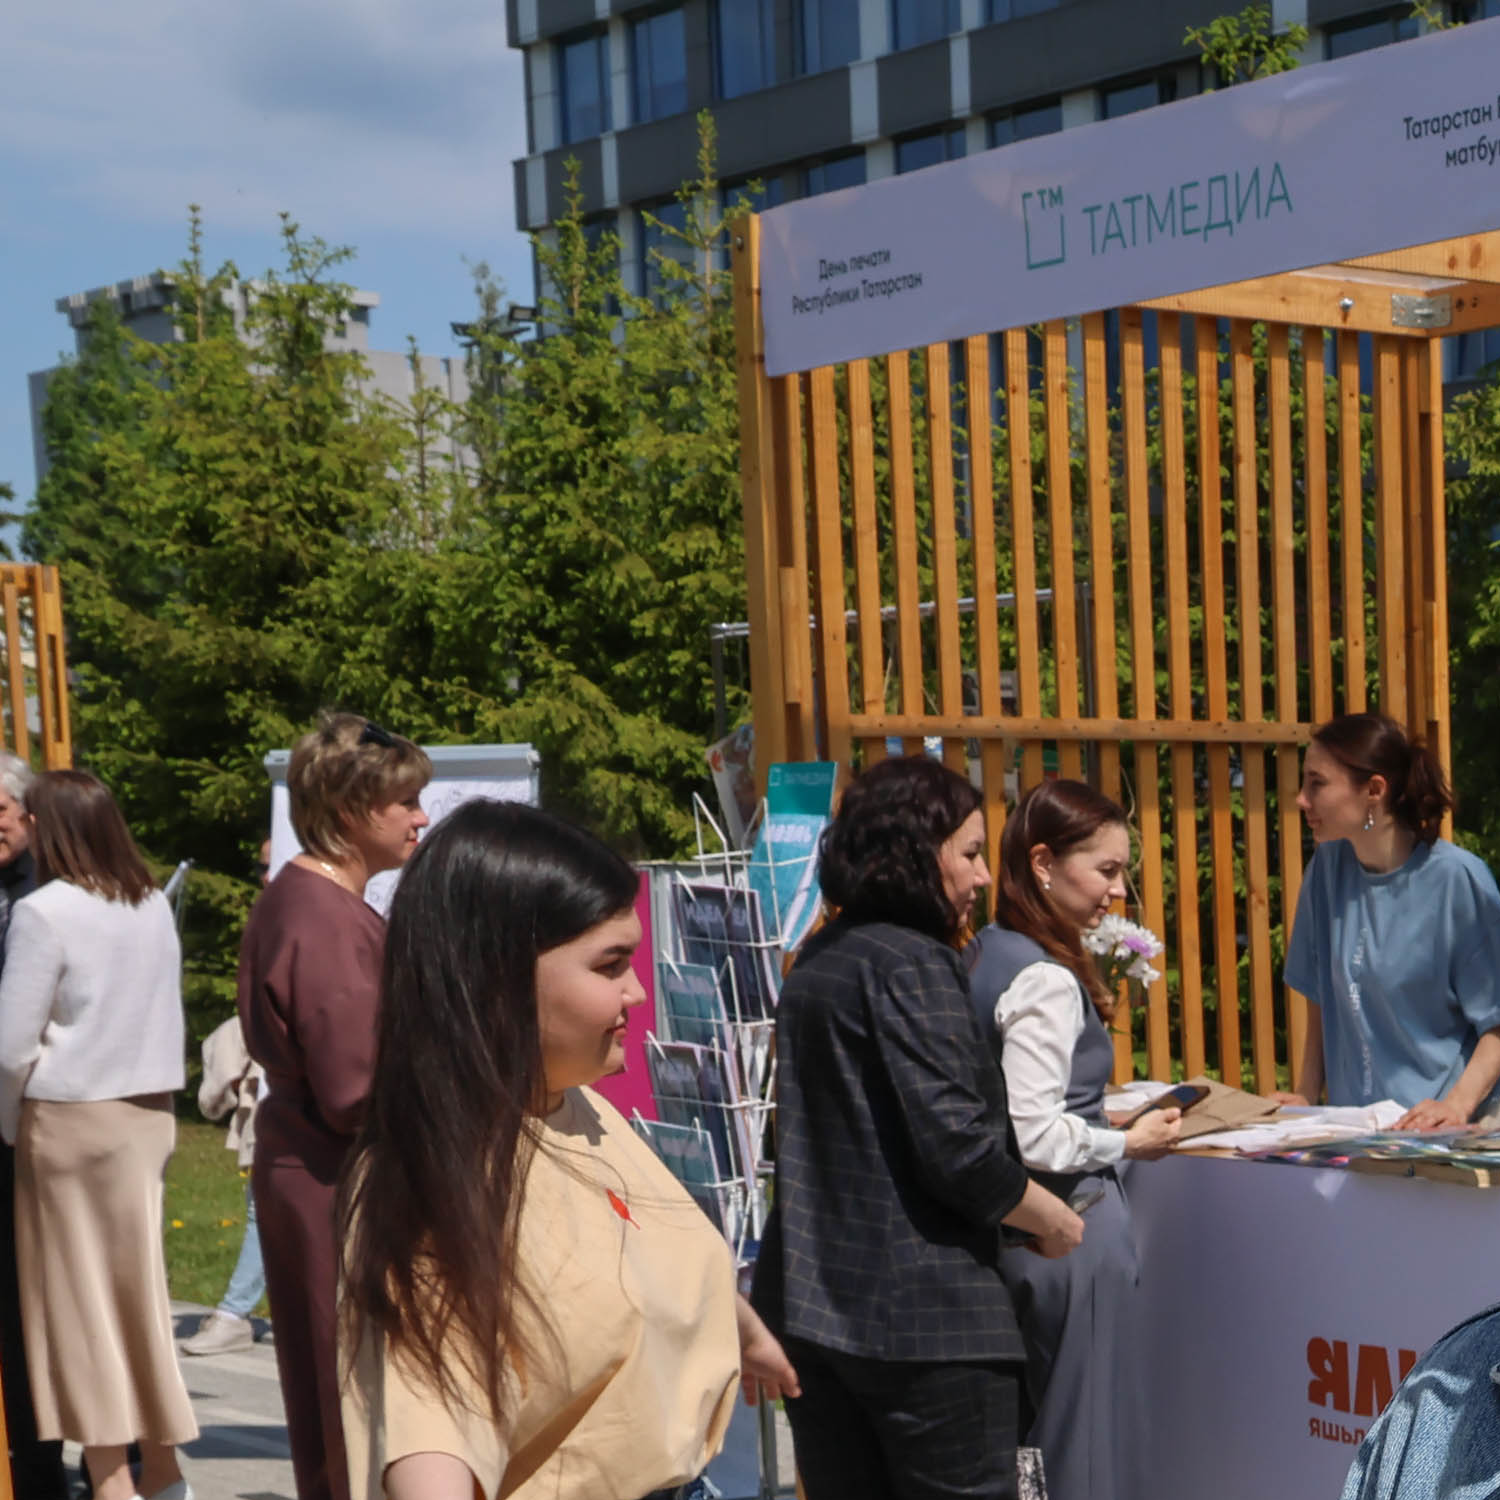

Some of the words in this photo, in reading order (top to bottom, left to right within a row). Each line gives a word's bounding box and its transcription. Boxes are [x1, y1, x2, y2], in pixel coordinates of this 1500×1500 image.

[1402, 104, 1493, 141] Татарстан
[1081, 161, 1294, 257] ТАТМЕДИА
[818, 257, 849, 282] День
[849, 248, 892, 271] печати
[791, 285, 861, 316] Республики
[860, 271, 924, 300] Татарстан
